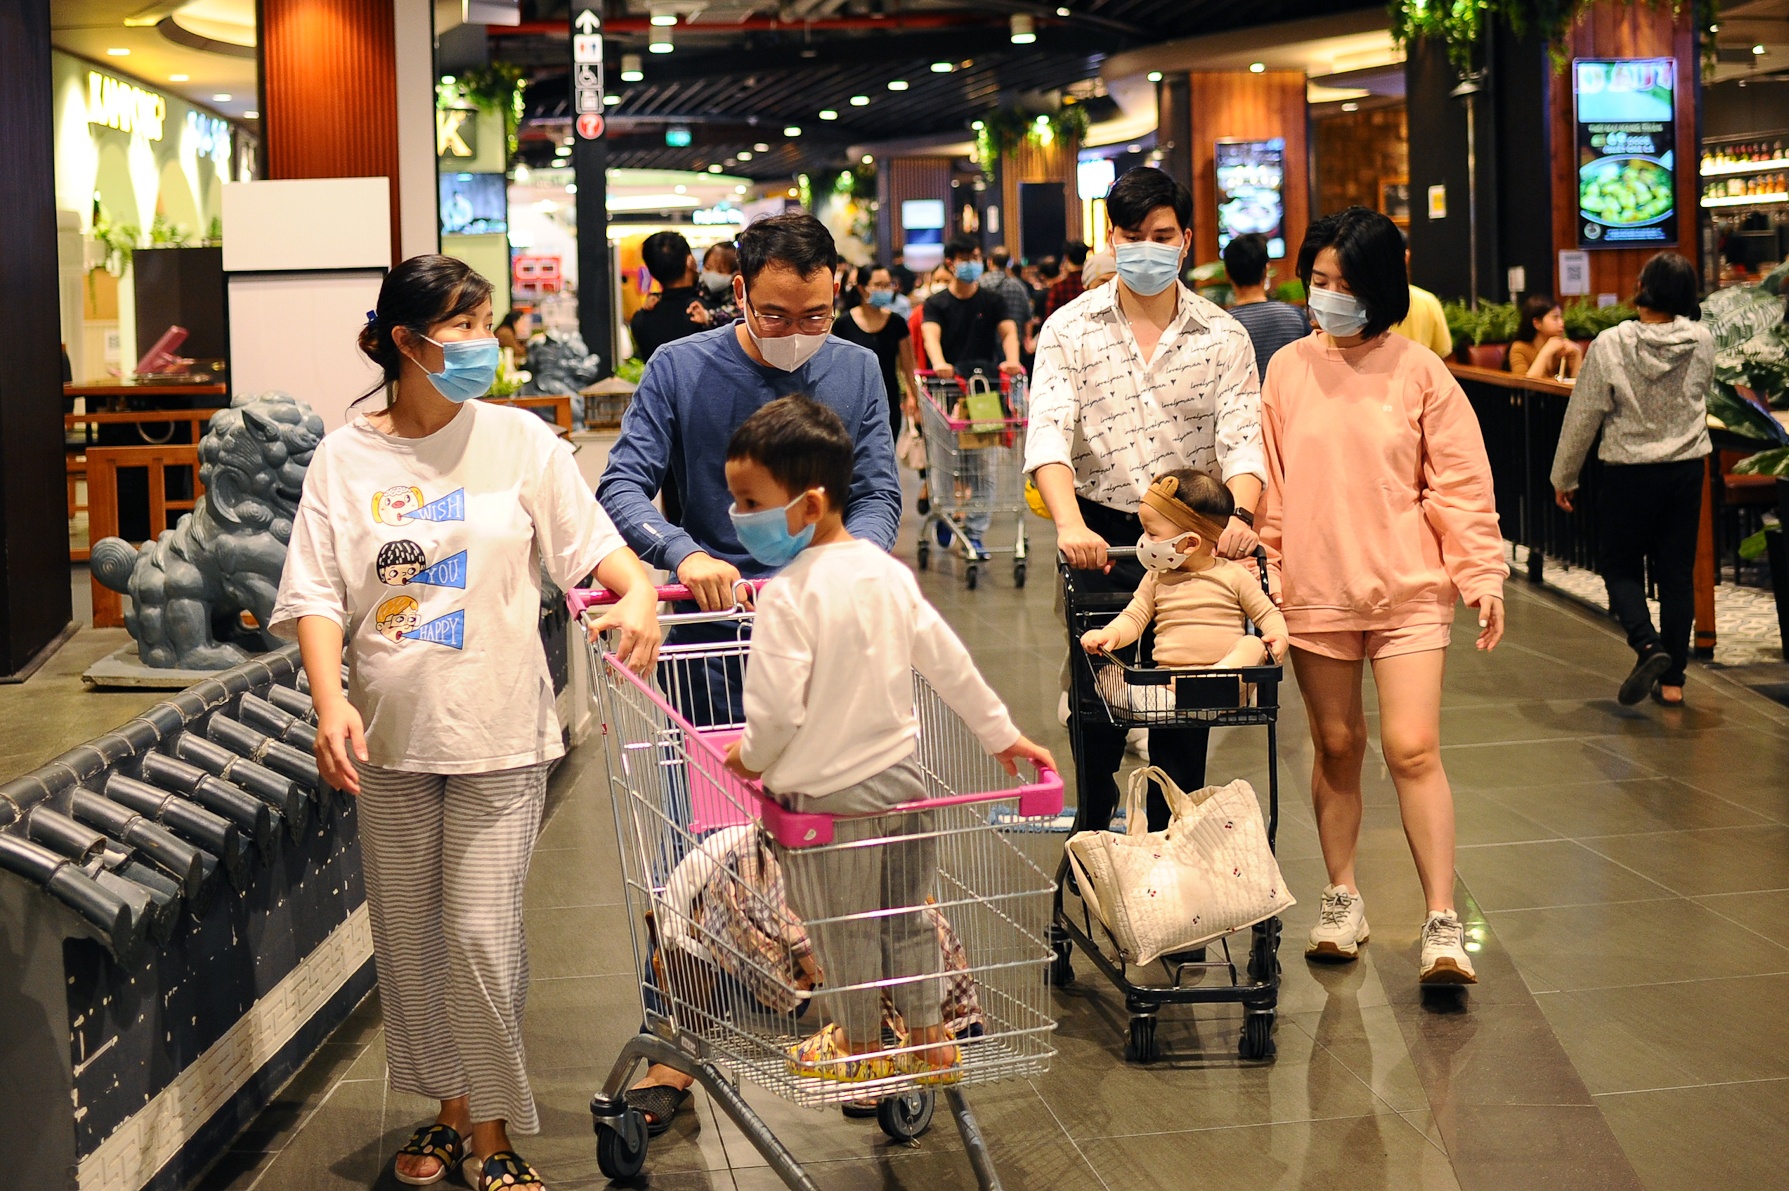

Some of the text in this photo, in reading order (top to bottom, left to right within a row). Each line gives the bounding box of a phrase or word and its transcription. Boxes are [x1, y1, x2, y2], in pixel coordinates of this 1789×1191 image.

[418, 495, 461, 521] WISH
[425, 559, 458, 584] YOU
[418, 617, 460, 645] HAPPY
